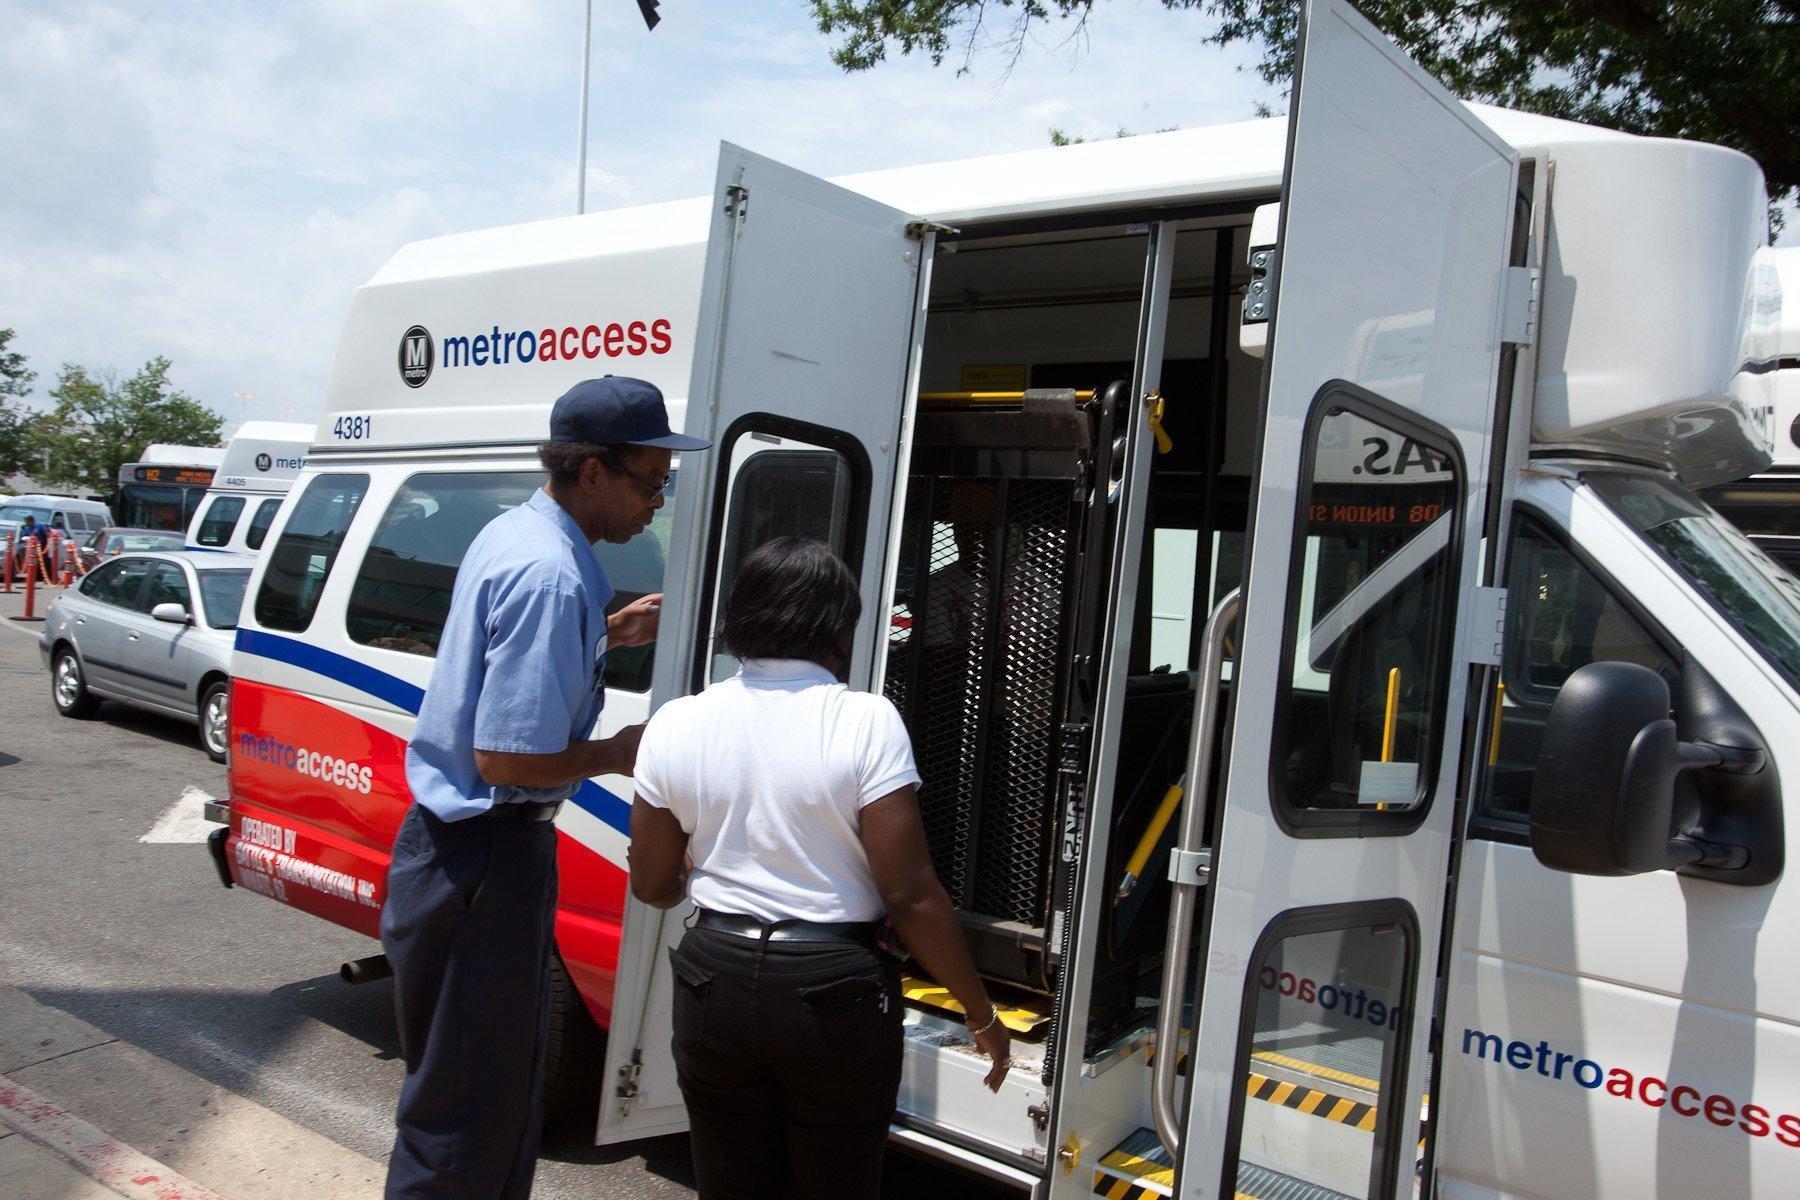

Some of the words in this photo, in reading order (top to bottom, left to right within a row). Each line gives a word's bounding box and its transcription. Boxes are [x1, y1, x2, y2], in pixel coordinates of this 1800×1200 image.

[443, 319, 672, 368] metroaccess
[405, 368, 427, 378] metro
[334, 416, 371, 440] 4381
[226, 477, 246, 487] 4405
[240, 732, 373, 794] metroaccess
[241, 816, 283, 851] OPERATED
[284, 828, 298, 855] BY
[1462, 1027, 1800, 1148] metroaccess
